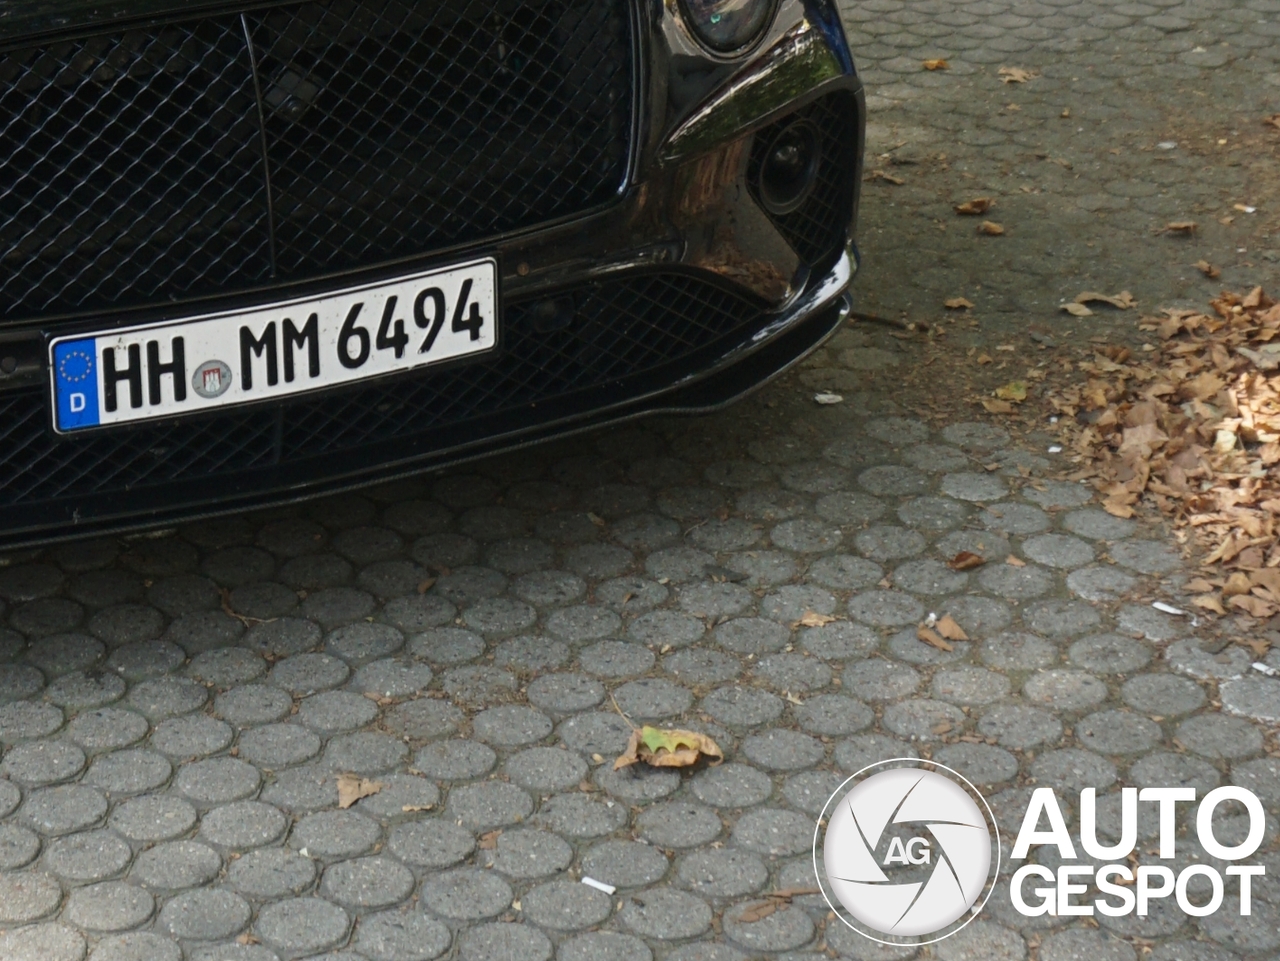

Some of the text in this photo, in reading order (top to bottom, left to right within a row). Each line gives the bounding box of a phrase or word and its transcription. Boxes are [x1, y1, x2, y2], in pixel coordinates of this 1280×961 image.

[102, 278, 484, 413] HH MM 6494
[70, 392, 86, 413] D
